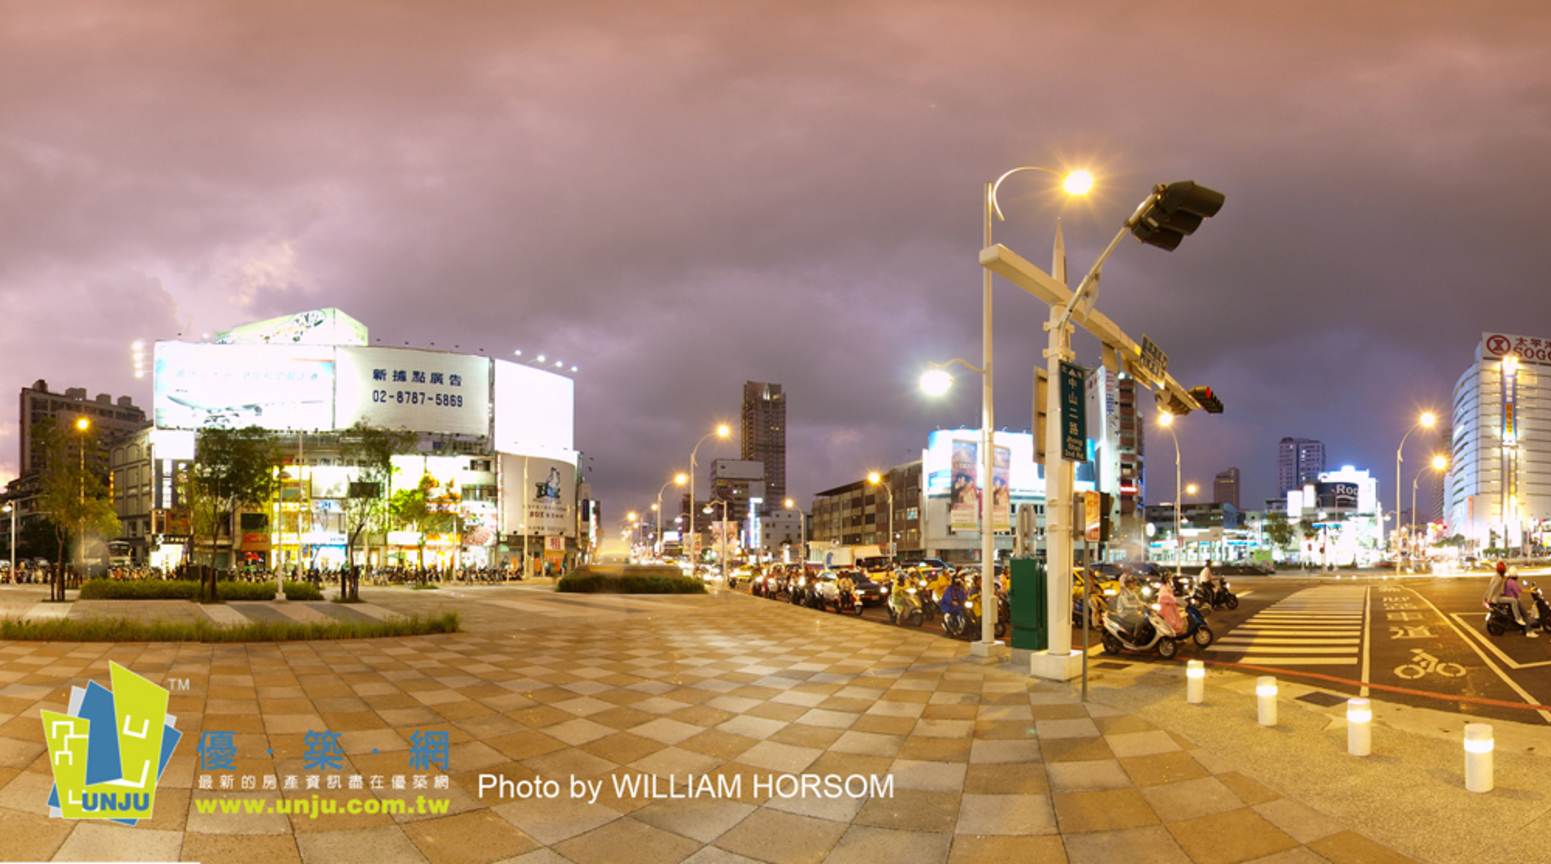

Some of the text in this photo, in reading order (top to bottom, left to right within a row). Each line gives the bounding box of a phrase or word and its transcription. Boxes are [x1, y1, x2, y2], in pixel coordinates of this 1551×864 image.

[372, 368, 462, 387] 新據點廣告
[372, 390, 463, 408] 02-8787-5869
[1067, 377, 1080, 436] 中山二路
[550, 537, 561, 550] 租
